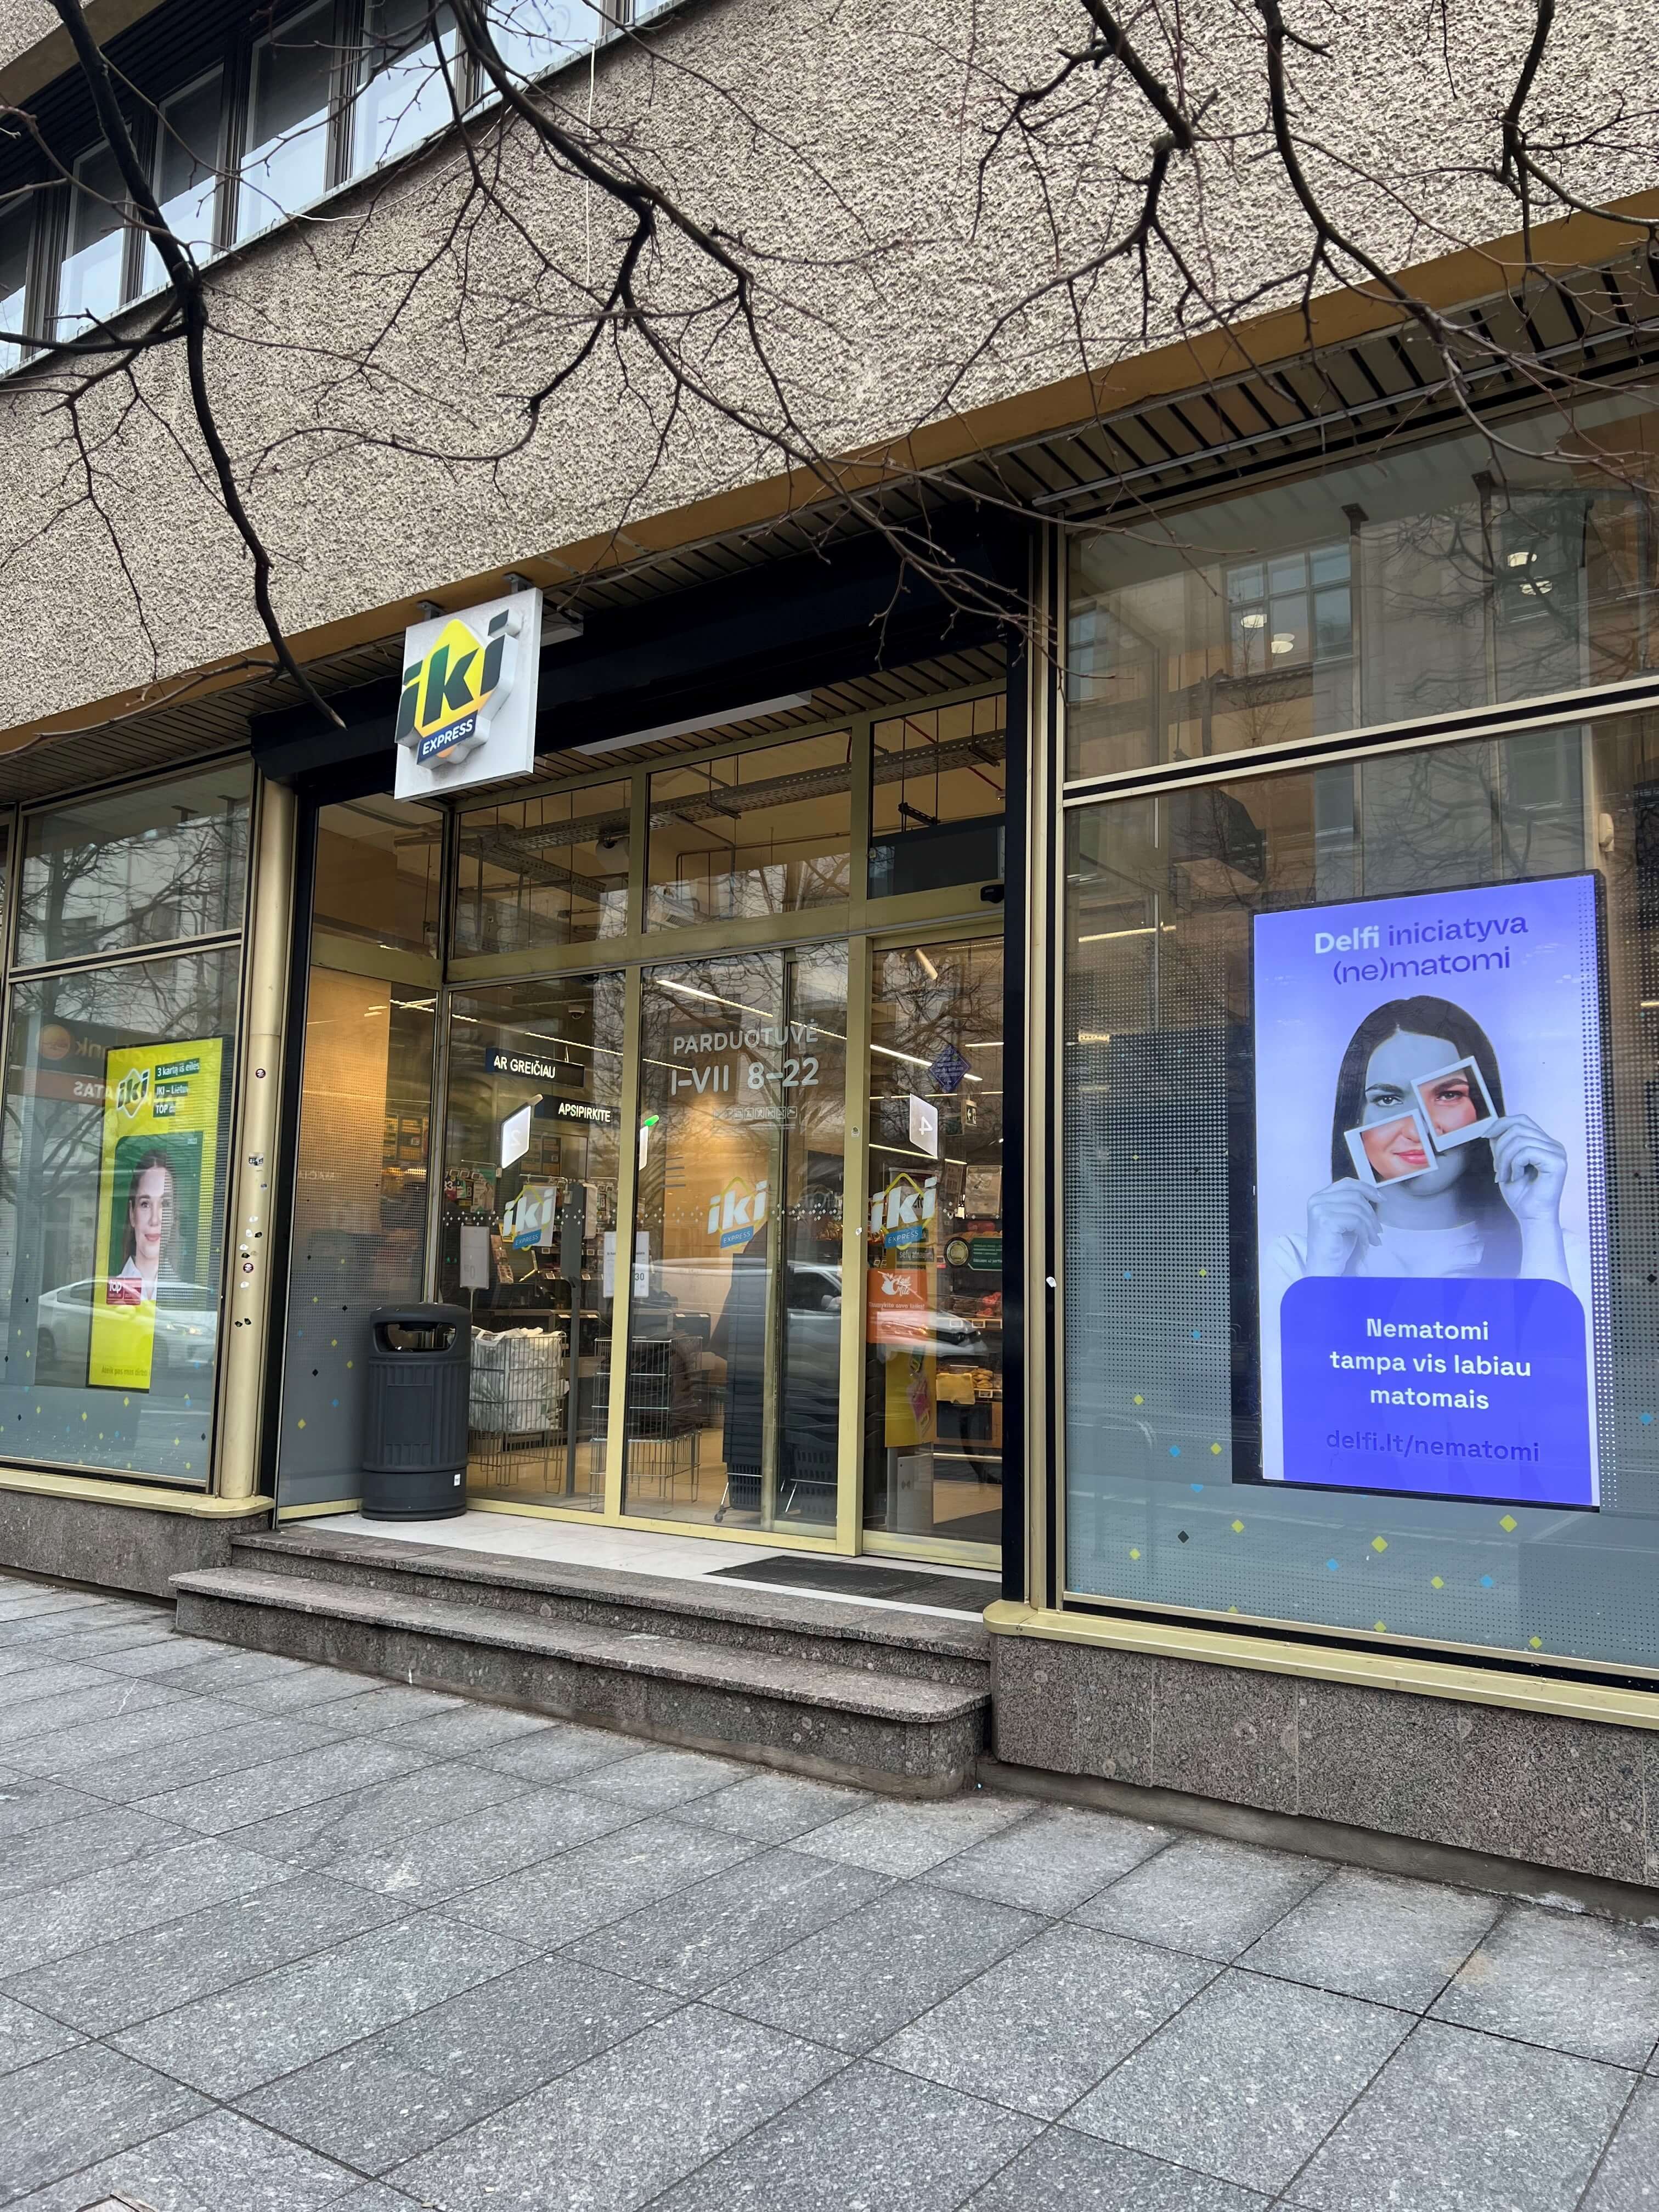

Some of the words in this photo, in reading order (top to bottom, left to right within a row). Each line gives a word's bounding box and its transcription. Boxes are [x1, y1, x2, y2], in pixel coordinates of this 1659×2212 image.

[394, 609, 510, 743] iki
[422, 719, 473, 755] EXPRESS
[1315, 926, 1379, 954] Delfi
[1389, 916, 1529, 946] iniciatyva
[1334, 946, 1510, 985] (ne)matomi
[673, 1018, 819, 1055] PARDUOTUVĖ
[157, 1068, 162, 1076] 3
[494, 1055, 507, 1070] AR
[510, 1058, 556, 1079] GREIČIAU
[117, 1071, 149, 1108] iki
[156, 1104, 168, 1114] TOP
[558, 1102, 611, 1122] APSIPIRKITE
[503, 1188, 554, 1236] iki
[708, 1180, 768, 1234] iki
[871, 1176, 937, 1235] iki
[516, 1234, 539, 1246] EXPRESS
[724, 1231, 751, 1243] EXPRESS
[888, 1231, 918, 1243] EXPRESS
[1367, 1318, 1488, 1340] Nematomi
[1329, 1351, 1406, 1375] tampa
[1413, 1353, 1447, 1373] vis
[1454, 1355, 1531, 1376] labiau
[1370, 1388, 1489, 1409] matomais
[1327, 1430, 1539, 1462] delfi.lt/nematomi
